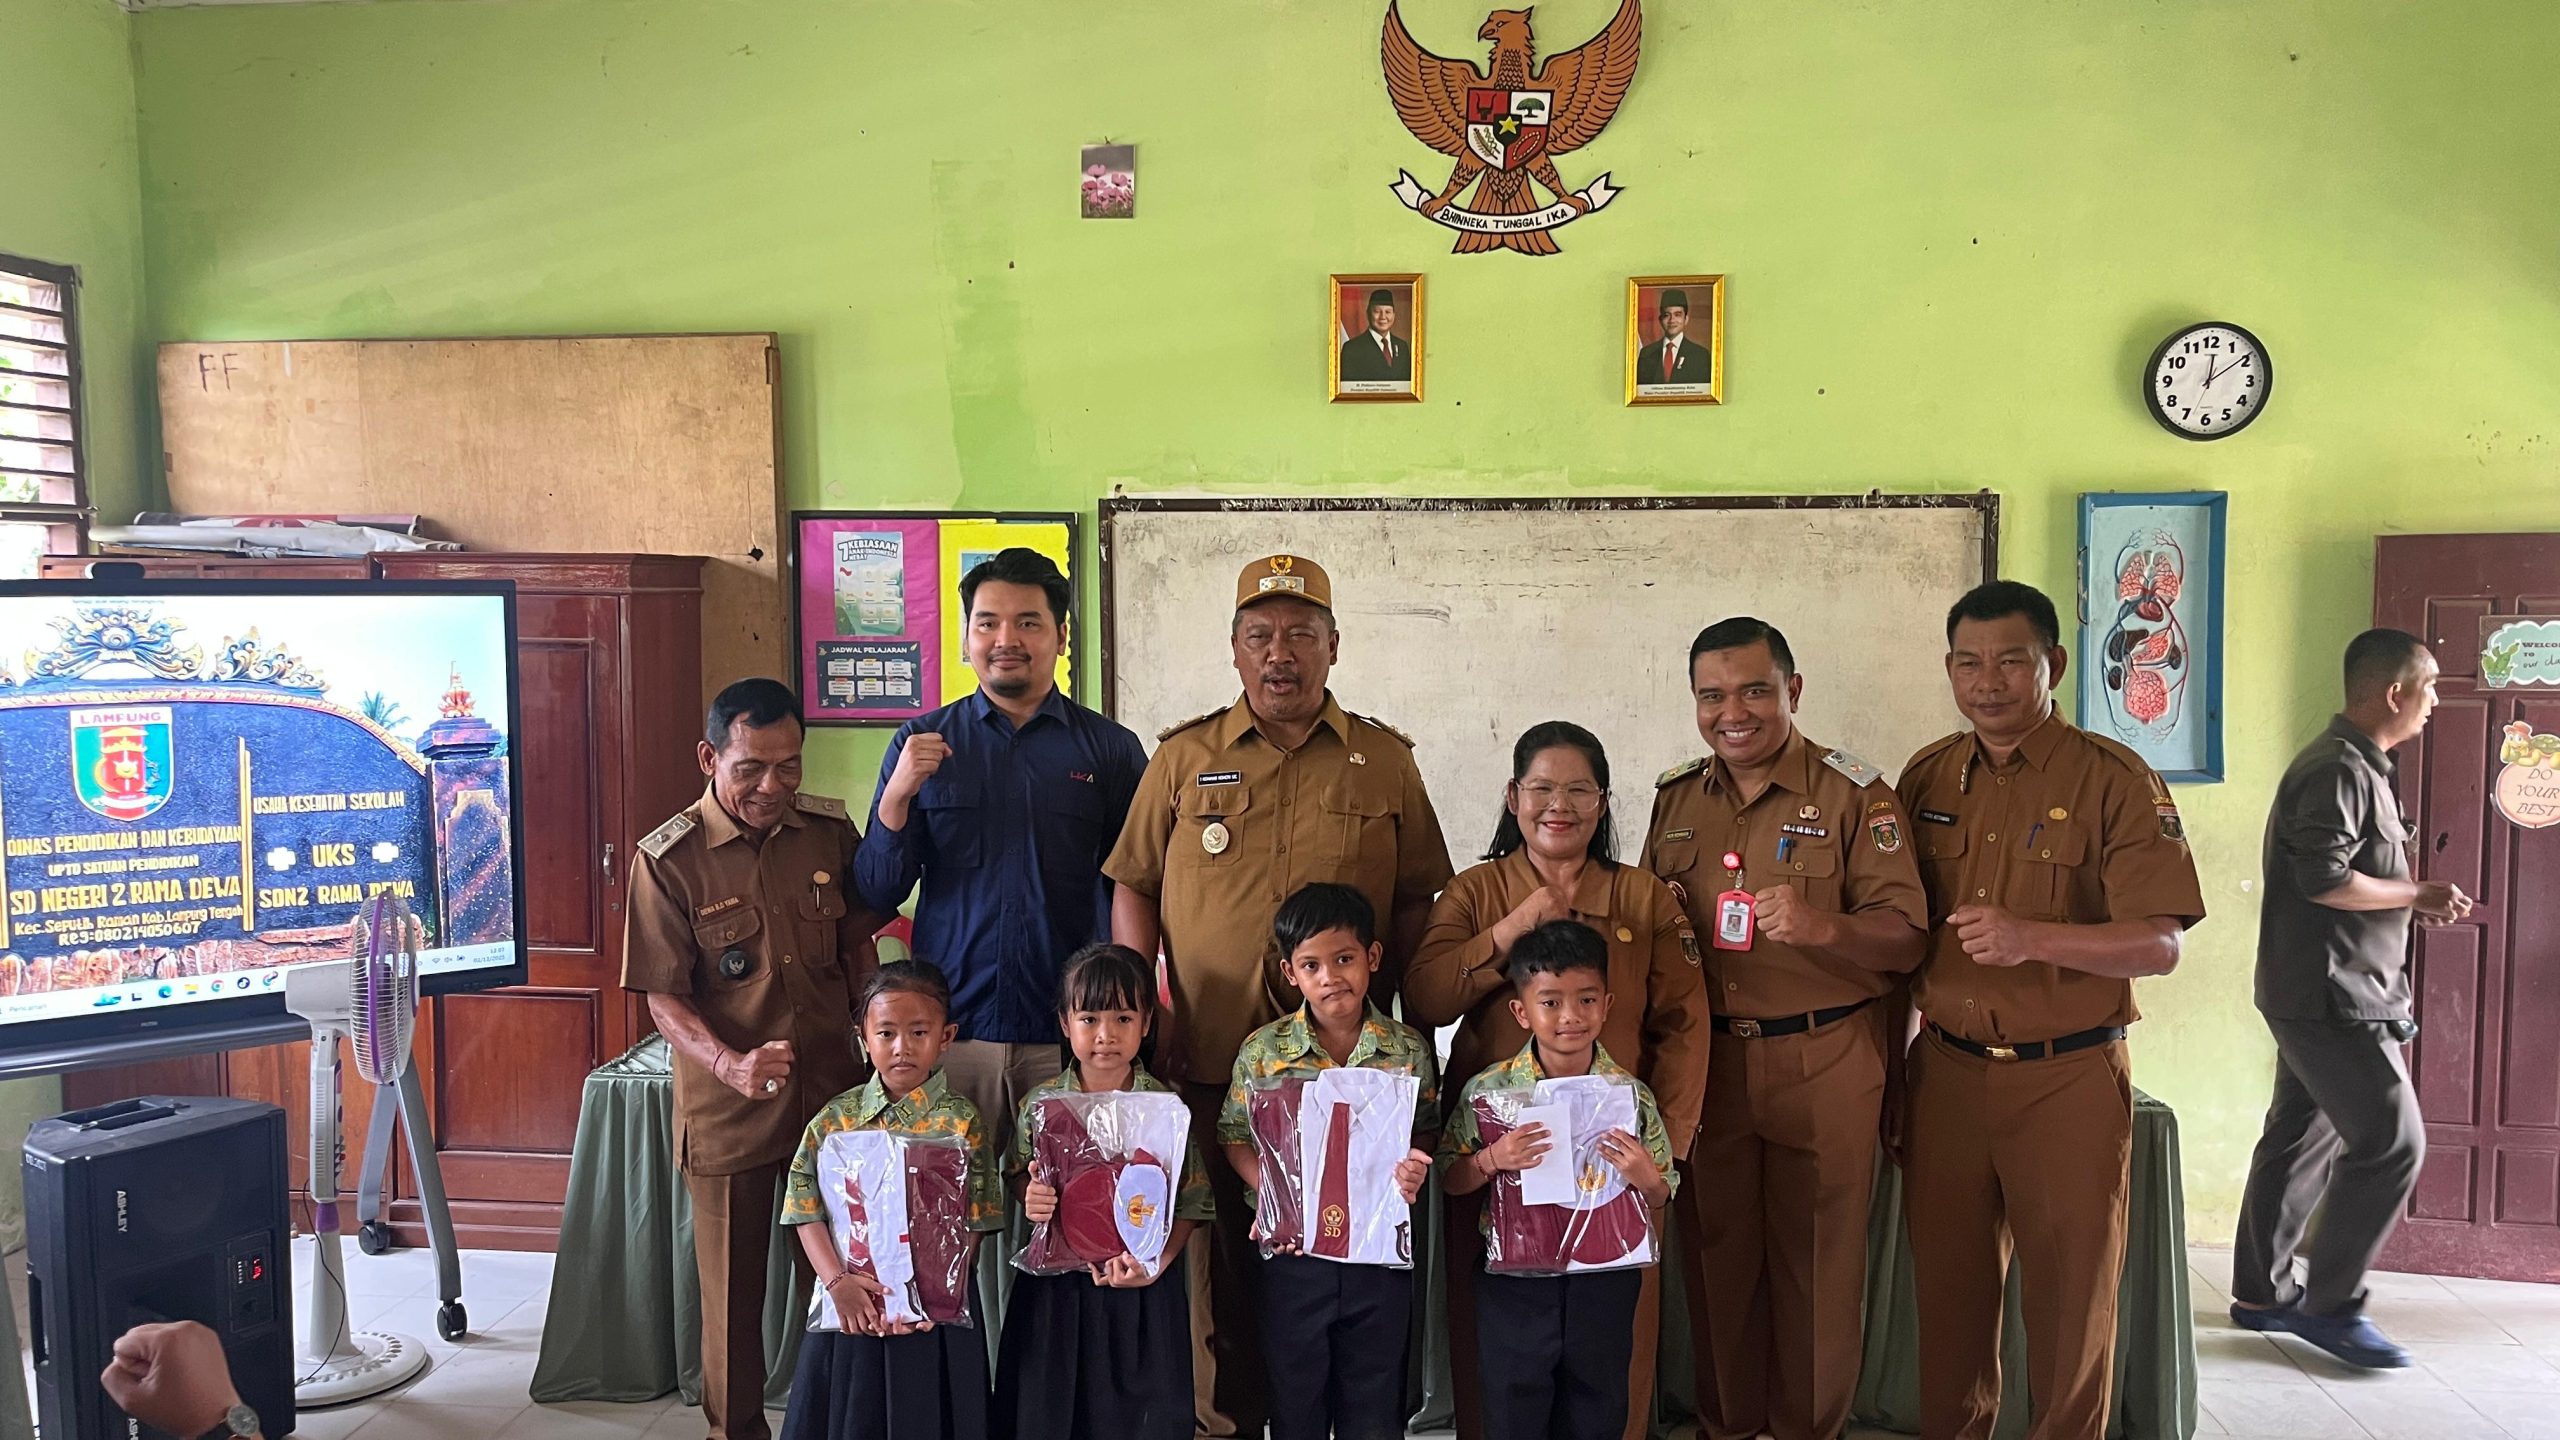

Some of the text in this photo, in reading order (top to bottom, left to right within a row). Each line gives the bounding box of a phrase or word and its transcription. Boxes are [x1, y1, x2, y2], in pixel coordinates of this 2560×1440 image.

[1440, 208, 1568, 229] BHINNEKA TUNGGAL IKA
[2184, 341, 2199, 354] 11
[2203, 336, 2220, 349] 12
[2229, 342, 2235, 353] 1
[2168, 356, 2186, 369] 10
[2241, 355, 2250, 367] 2
[2162, 375, 2173, 388] 9
[2245, 375, 2254, 388] 3
[2166, 395, 2177, 407] 8
[2236, 395, 2247, 407] 4
[2182, 408, 2191, 420] 7
[2200, 414, 2211, 426] 6
[2221, 408, 2231, 421] 5
[849, 539, 898, 552] KEBIASAAN
[2528, 768, 2553, 780] DO
[2517, 784, 2560, 799] YOUR
[350, 791, 405, 810] SEKOLAH
[2517, 803, 2560, 816] BEST
[6, 826, 243, 857] DINAS PENDIDIKAN DAN KEBUDAYAAN
[312, 844, 356, 867] UKS
[83, 859, 127, 875] SATUAN
[129, 854, 200, 872] PENDIDIKAN
[10, 876, 242, 915] SD NEGERI 2 RAMA DEWA
[259, 886, 309, 909] SDN2
[318, 884, 363, 905] RAMA
[97, 914, 140, 930] Raman
[209, 905, 244, 920] Tengah
[117, 1190, 128, 1233] ASHLEY
[1324, 1226, 1341, 1238] SD
